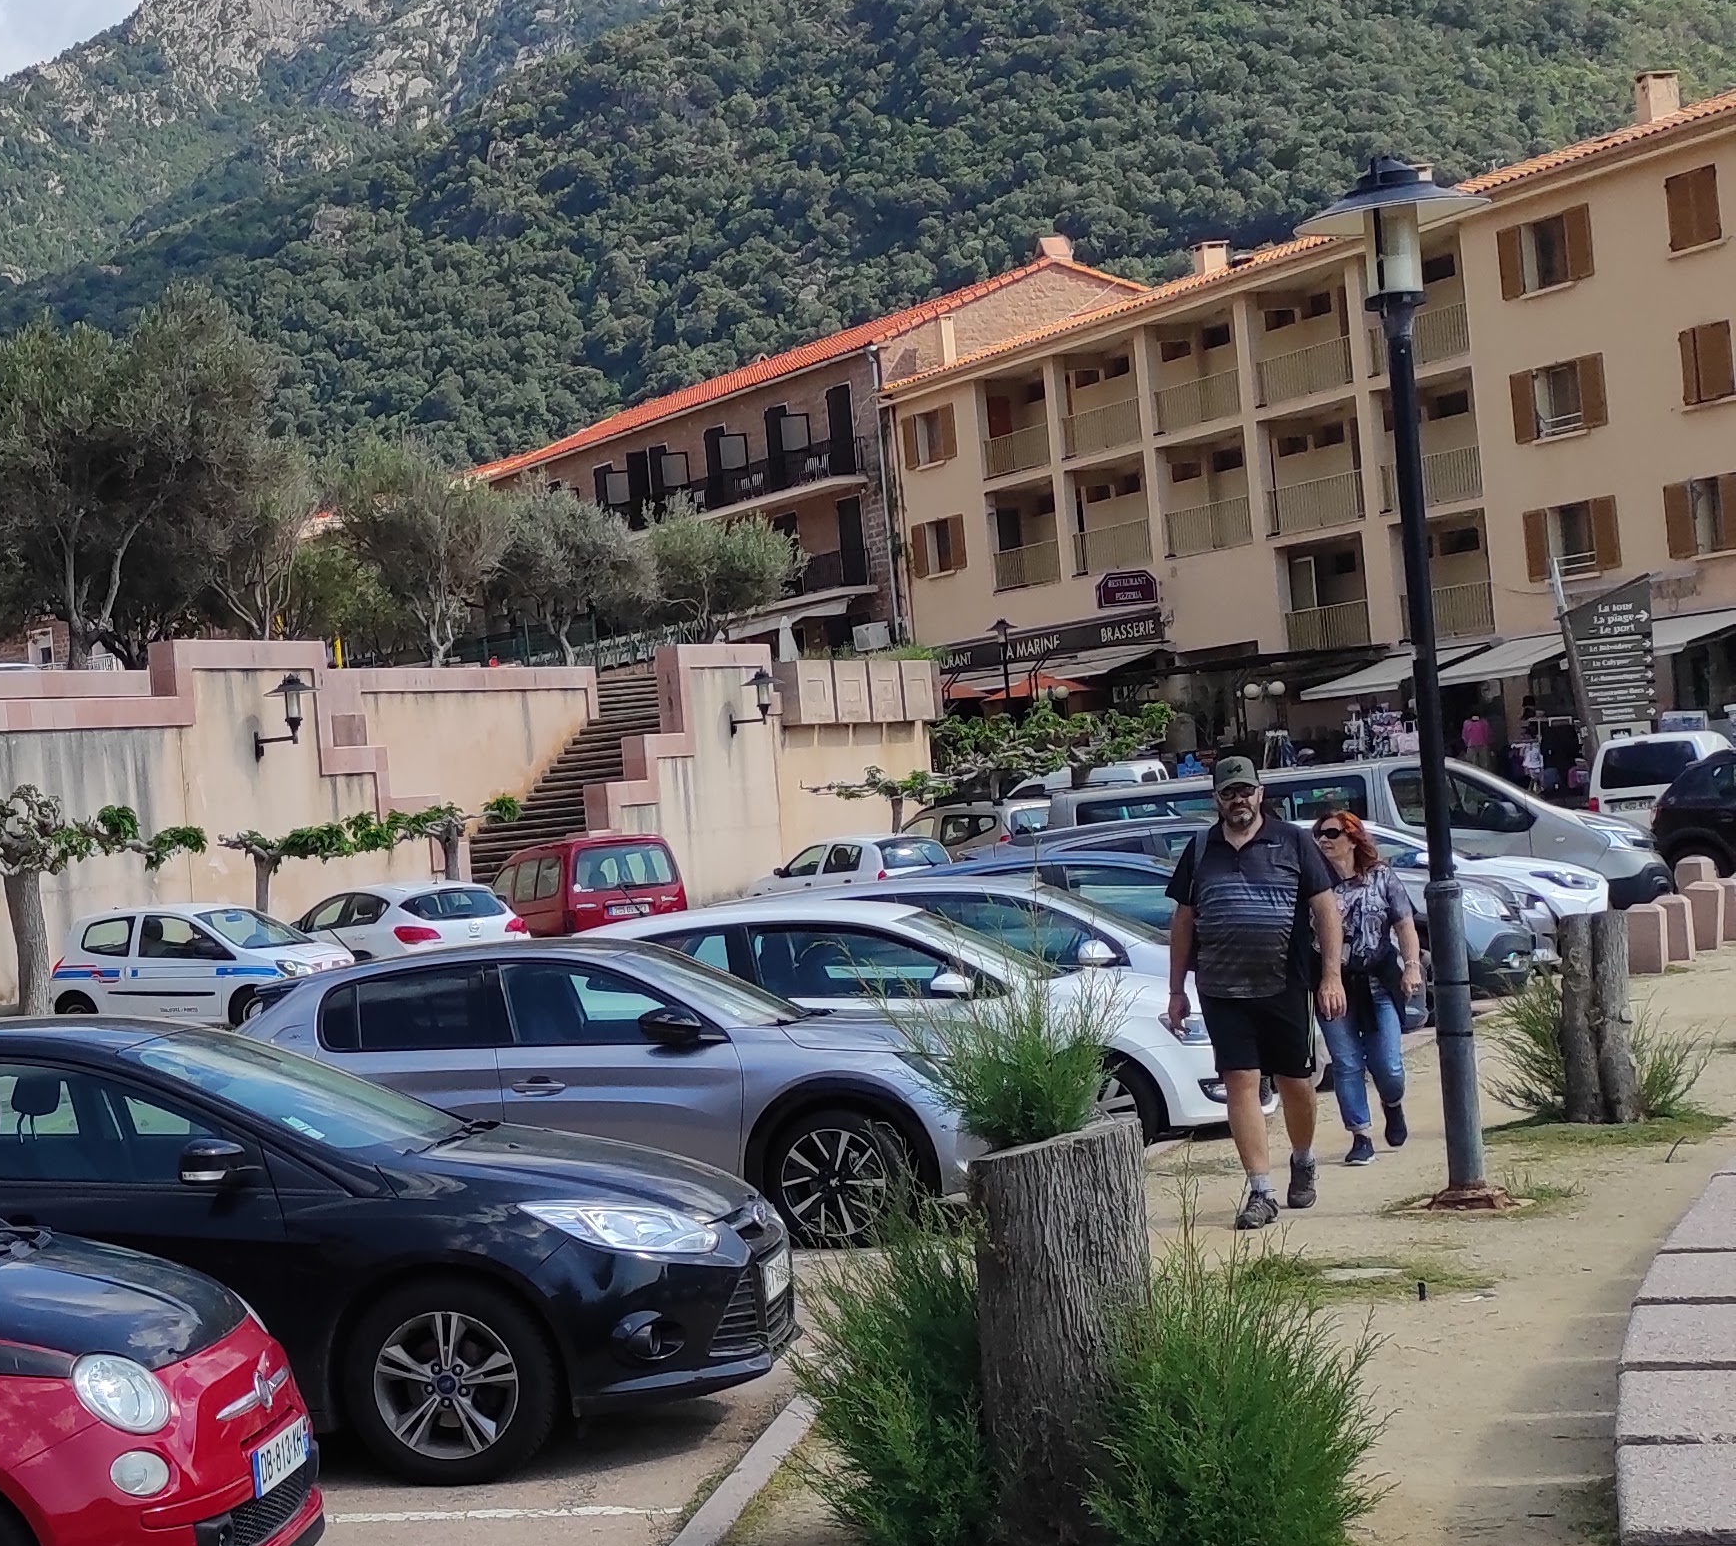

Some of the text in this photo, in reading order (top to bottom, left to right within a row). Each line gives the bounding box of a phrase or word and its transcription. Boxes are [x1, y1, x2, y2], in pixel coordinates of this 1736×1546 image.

[1107, 576, 1146, 588] RESTAURANT
[1598, 603, 1609, 613] La
[1593, 613, 1635, 626] La plage
[1100, 619, 1156, 644] BRASSERIE
[1599, 623, 1635, 635] Le port
